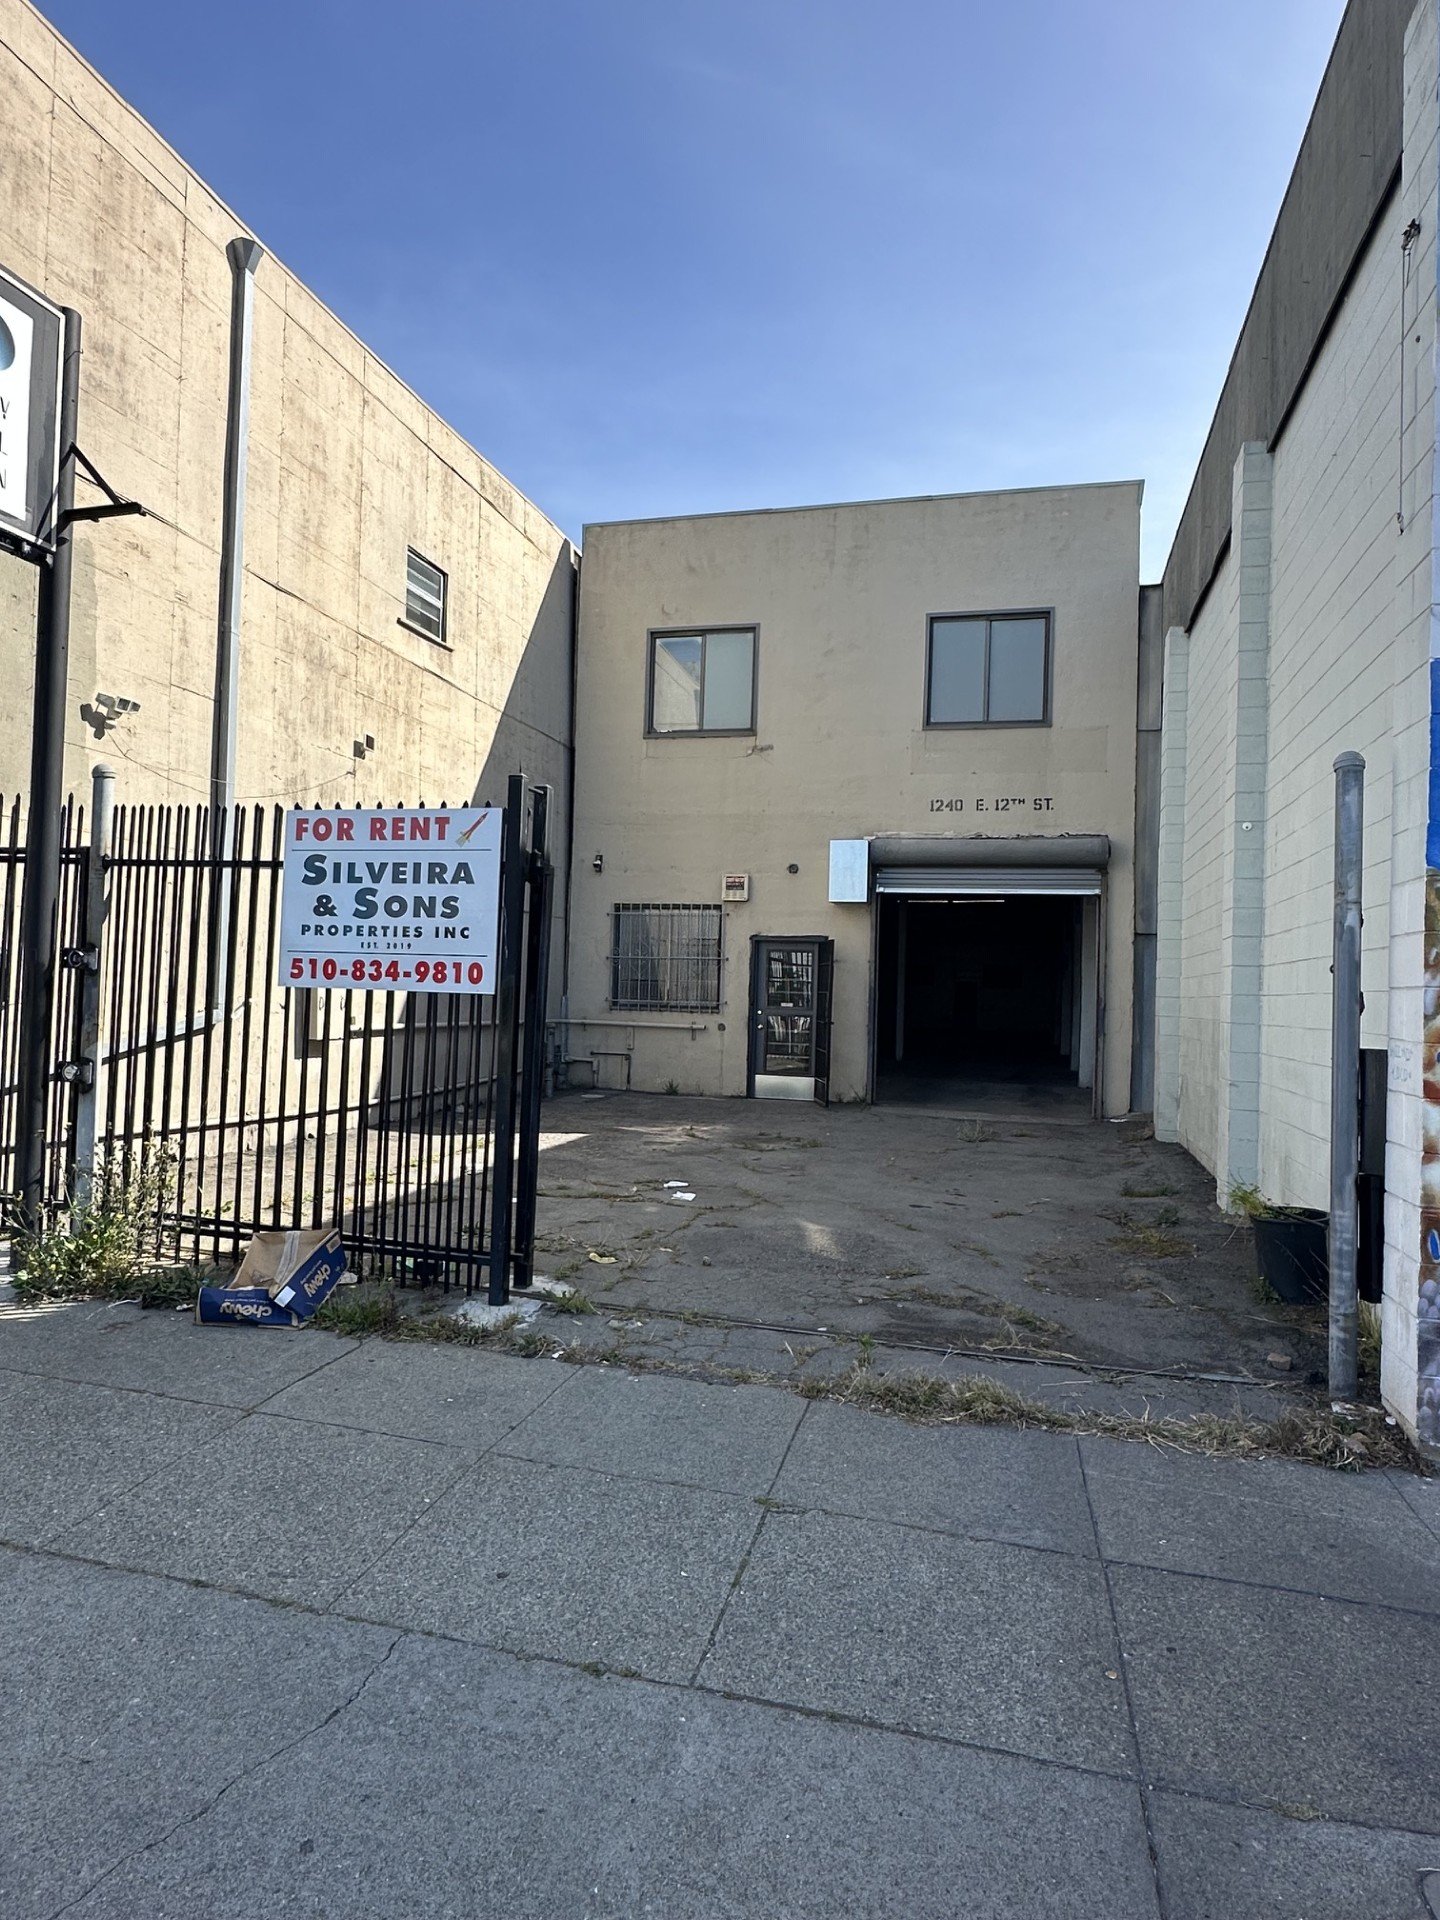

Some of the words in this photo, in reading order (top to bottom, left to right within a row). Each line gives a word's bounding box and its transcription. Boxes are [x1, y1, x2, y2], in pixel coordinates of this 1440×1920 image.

[930, 799, 963, 812] 1240
[976, 799, 989, 811] E.
[995, 798, 1025, 811] 12TH
[1033, 798, 1054, 811] ST.
[295, 817, 354, 842] FOR
[369, 816, 451, 841] RENT
[301, 853, 475, 886] SILVEIRA
[312, 894, 338, 917] &
[352, 887, 460, 920] SONS
[301, 924, 423, 938] PROPERTIES
[434, 926, 471, 939] INC
[360, 941, 379, 949] EST.
[386, 942, 412, 950] 2019
[289, 958, 484, 985] 510-834-9810
[303, 1263, 331, 1298] chewy
[219, 1301, 273, 1318] chewy
